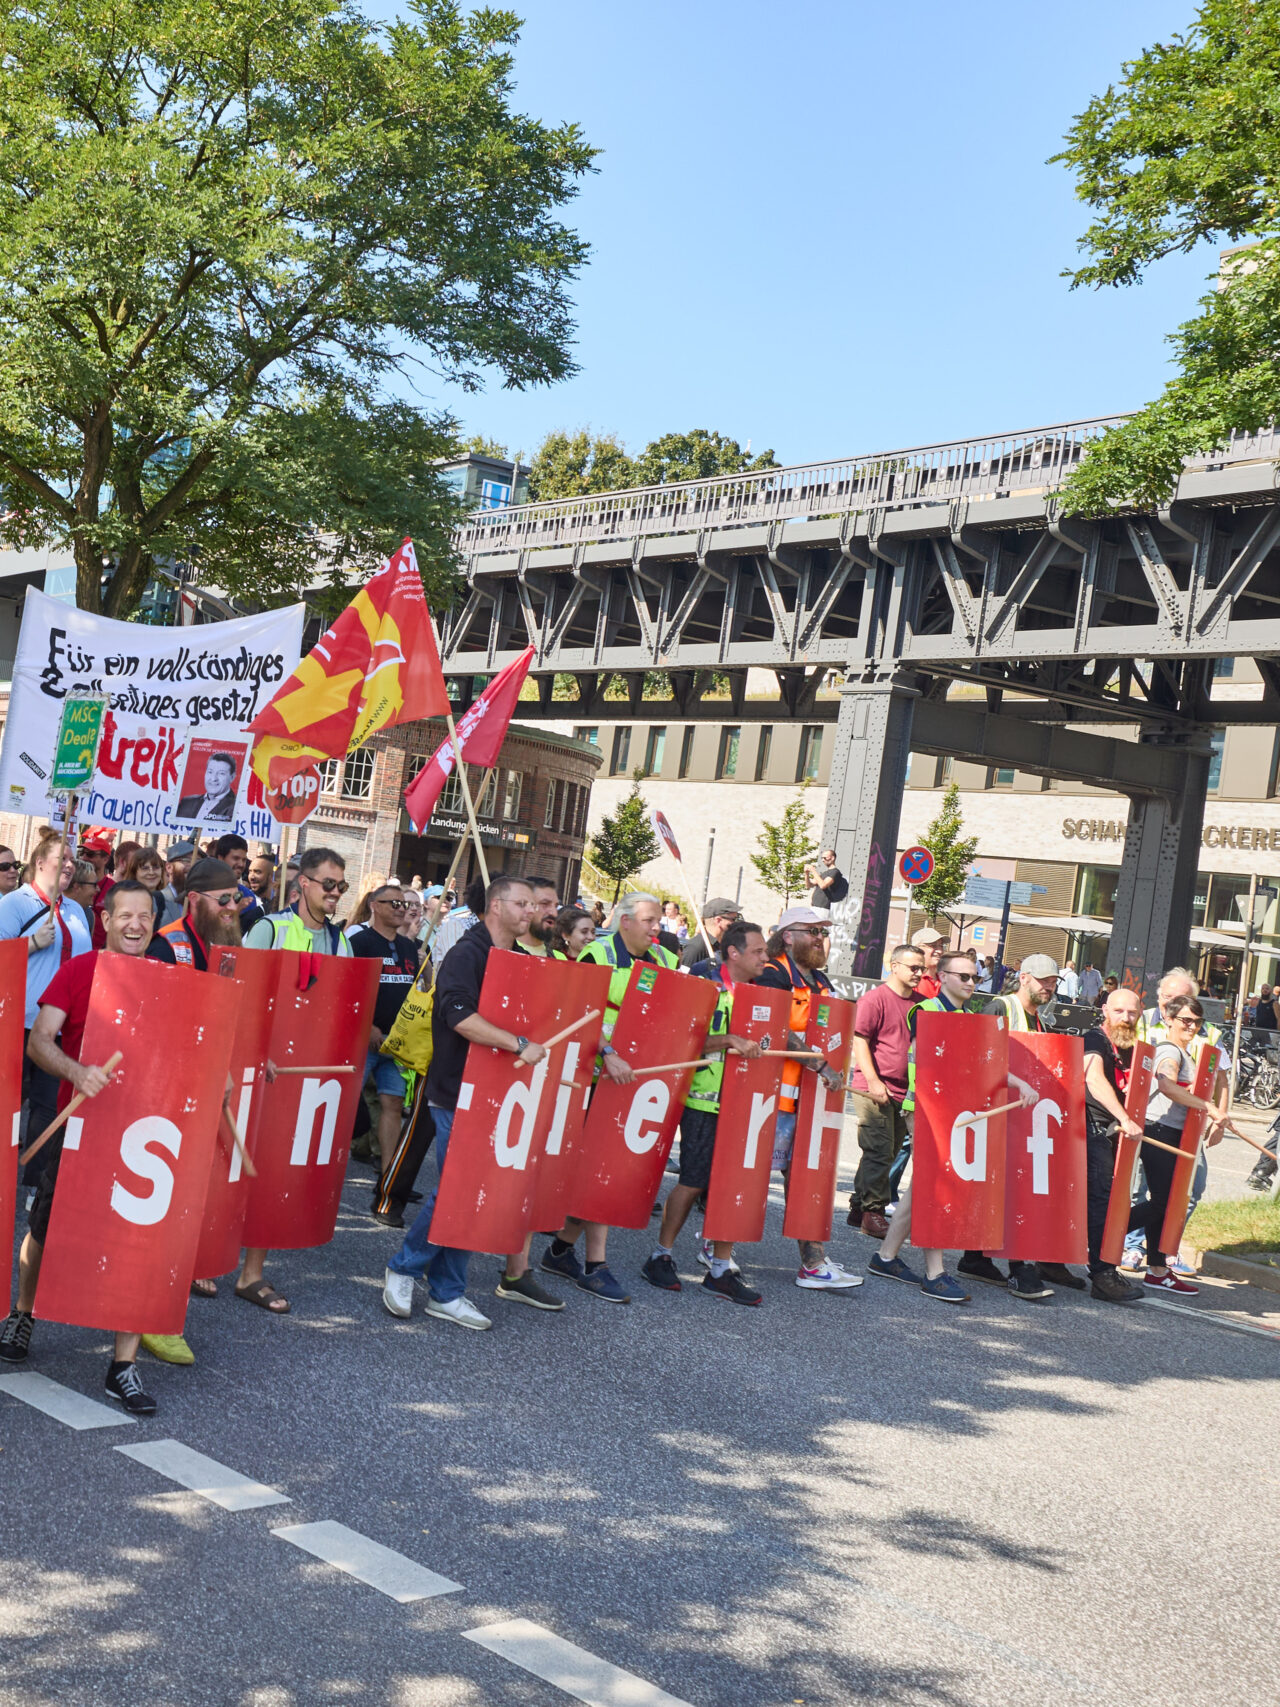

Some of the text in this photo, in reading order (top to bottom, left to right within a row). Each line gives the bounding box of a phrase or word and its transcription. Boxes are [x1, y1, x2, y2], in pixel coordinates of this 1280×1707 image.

[49, 628, 283, 690] Für ein vollständiges
[70, 706, 98, 723] MSC
[185, 689, 258, 725] gesetzl.
[63, 729, 96, 745] Deal?
[250, 811, 271, 838] HH
[290, 1078, 342, 1165] n
[624, 1078, 670, 1155] e
[743, 1092, 775, 1169] r
[950, 1110, 988, 1182] a
[1026, 1098, 1062, 1195] f
